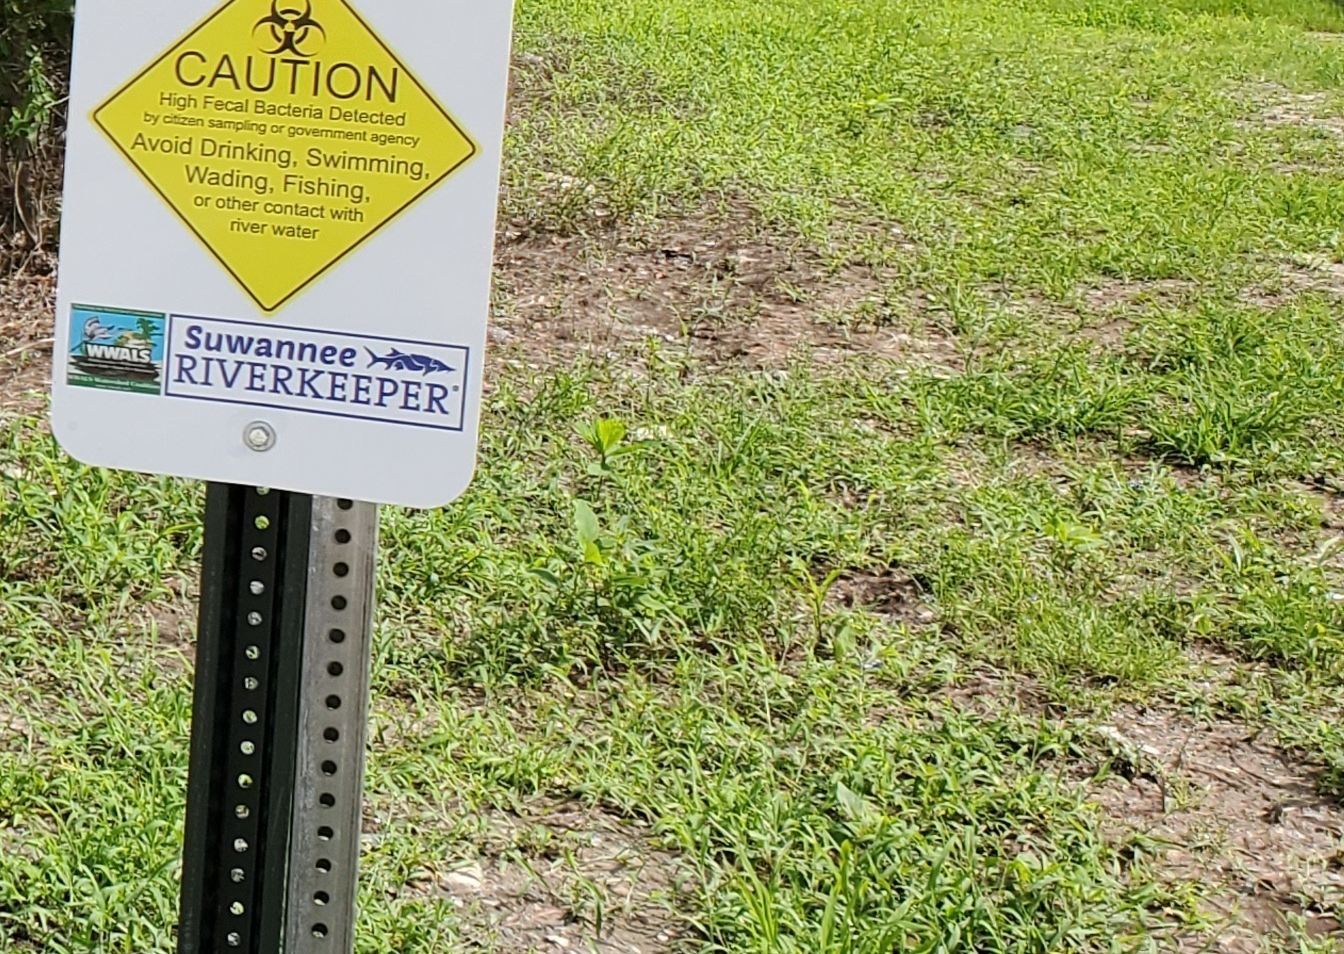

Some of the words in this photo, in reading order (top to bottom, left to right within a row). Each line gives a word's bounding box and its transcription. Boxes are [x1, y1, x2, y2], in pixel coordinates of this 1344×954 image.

[176, 51, 398, 103] CAUTION
[159, 92, 198, 111] High
[203, 95, 249, 113] Fecal
[254, 100, 323, 120] Bacteria
[329, 106, 407, 127] Detected
[144, 112, 160, 126] by
[163, 113, 204, 127] citizen
[208, 118, 267, 135] sampling
[270, 124, 285, 134] or
[288, 125, 368, 142] government
[370, 133, 421, 149] agency
[131, 132, 193, 155] Avoid
[201, 138, 298, 169] Drinking,
[307, 147, 430, 181] Swimming,
[185, 164, 274, 195] Wading,
[283, 173, 371, 204] Fishing,
[194, 195, 212, 207] or
[215, 196, 260, 212] other
[264, 201, 327, 219] contact
[330, 207, 364, 223] with
[230, 218, 268, 235] river
[272, 223, 320, 240] water
[86, 343, 152, 364] WWALS
[184, 324, 357, 368] Suwannee
[173, 353, 450, 415] RIVERKEEPER
